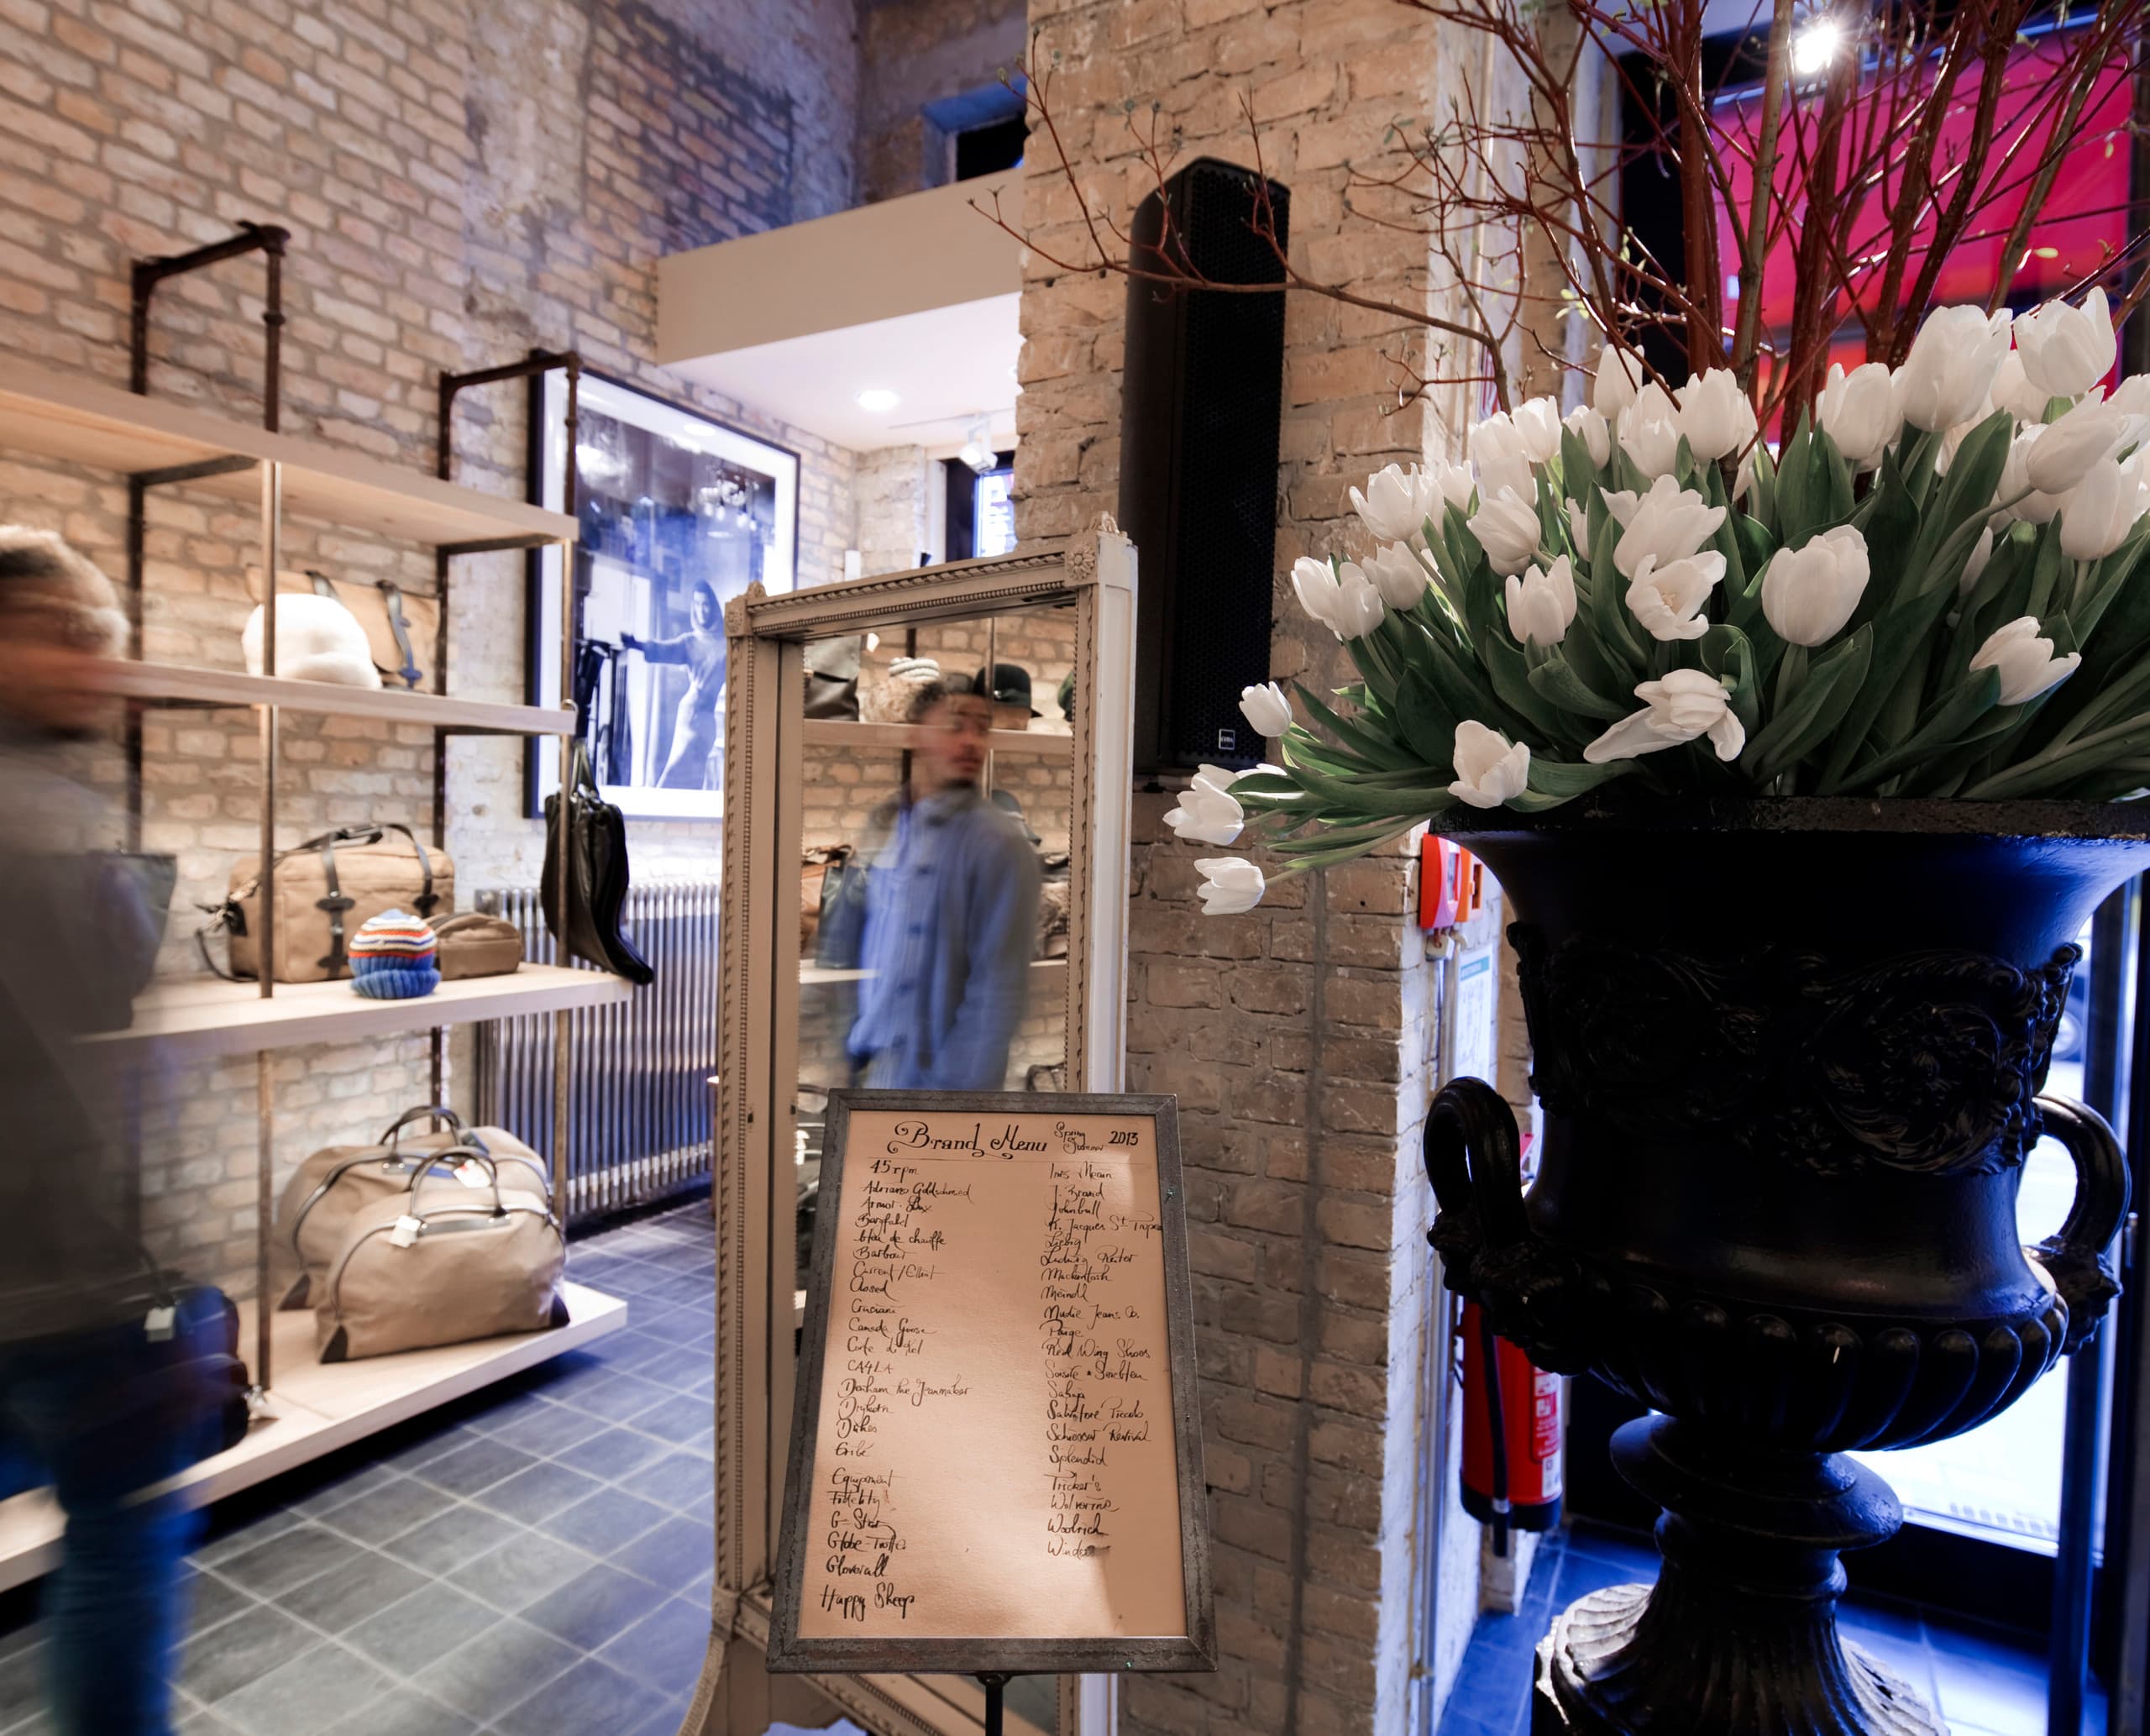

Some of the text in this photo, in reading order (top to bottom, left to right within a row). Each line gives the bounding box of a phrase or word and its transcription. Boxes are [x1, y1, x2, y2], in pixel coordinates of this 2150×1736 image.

[887, 1120, 1047, 1157] Brand Menu
[1054, 1121, 1086, 1146] Spring
[1062, 1136, 1104, 1154] Summer
[1108, 1130, 1139, 1146] 2013
[861, 1180, 909, 1196] Adriano
[1064, 1182, 1105, 1202] Brand
[1049, 1198, 1101, 1223] Johnbull
[889, 1230, 905, 1250] de
[1068, 1219, 1105, 1243] Jacques
[853, 1245, 911, 1260] Barbour
[1041, 1246, 1089, 1275] Ludwig
[850, 1276, 898, 1300] Closed
[1041, 1282, 1088, 1302] Meindl
[852, 1298, 900, 1314] Cruciani
[1044, 1304, 1083, 1319] Nudie
[849, 1317, 937, 1347] Canada Goose
[1039, 1319, 1083, 1345] Paige
[1041, 1337, 1151, 1369] Red Wing Shoes
[847, 1360, 894, 1374] CA4LA
[837, 1376, 889, 1398] Denham
[896, 1378, 910, 1394] the
[1047, 1396, 1144, 1423] Salvatore Piccolo
[1102, 1420, 1152, 1442] Revival
[1049, 1445, 1108, 1472] Splendid
[1043, 1470, 1102, 1492] Tricker's
[826, 1490, 880, 1518] Fidelity
[1051, 1492, 1120, 1512] Wolverine
[1047, 1513, 1109, 1536] Woolrich
[826, 1553, 889, 1577] Gloverall
[820, 1582, 915, 1622] Happy Sheep
